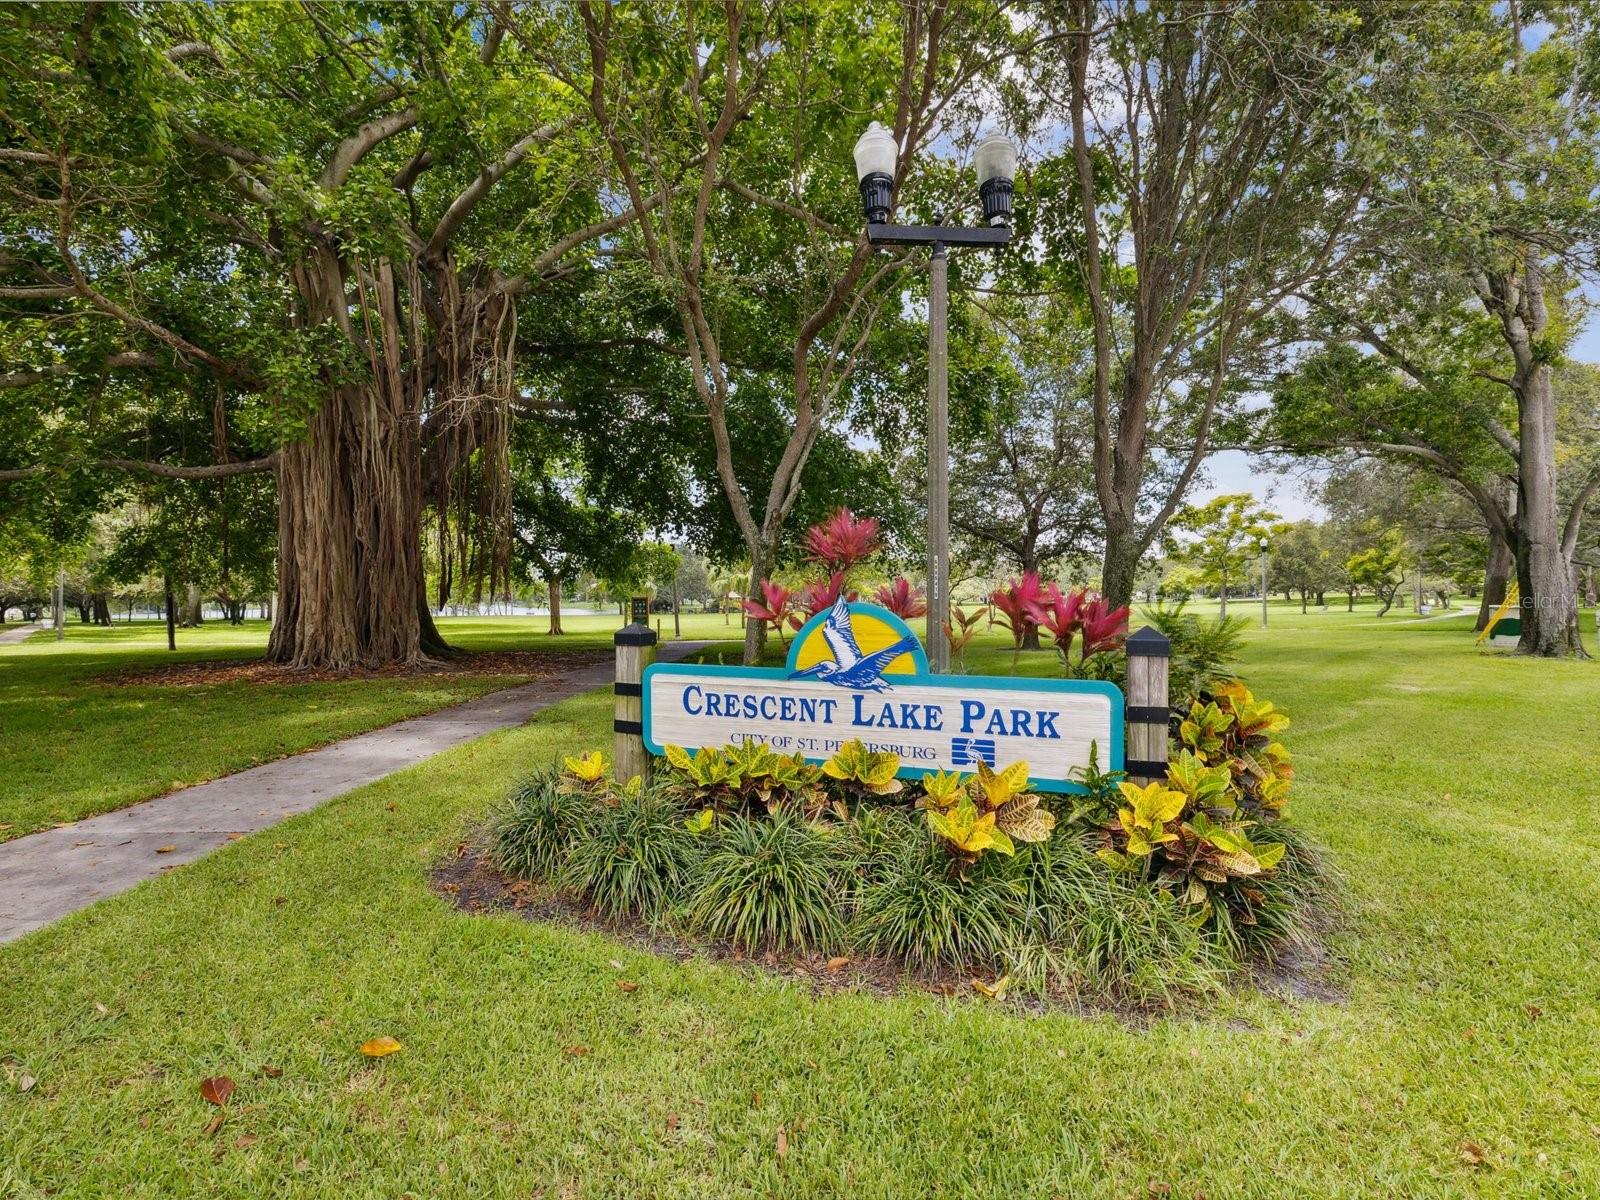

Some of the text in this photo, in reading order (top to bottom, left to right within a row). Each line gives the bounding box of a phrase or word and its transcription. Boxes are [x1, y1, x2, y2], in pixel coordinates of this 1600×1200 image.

[682, 684, 1061, 740] CRESCENT LAKE PARK
[730, 732, 937, 760] CITY OF ST. PERSBURG
